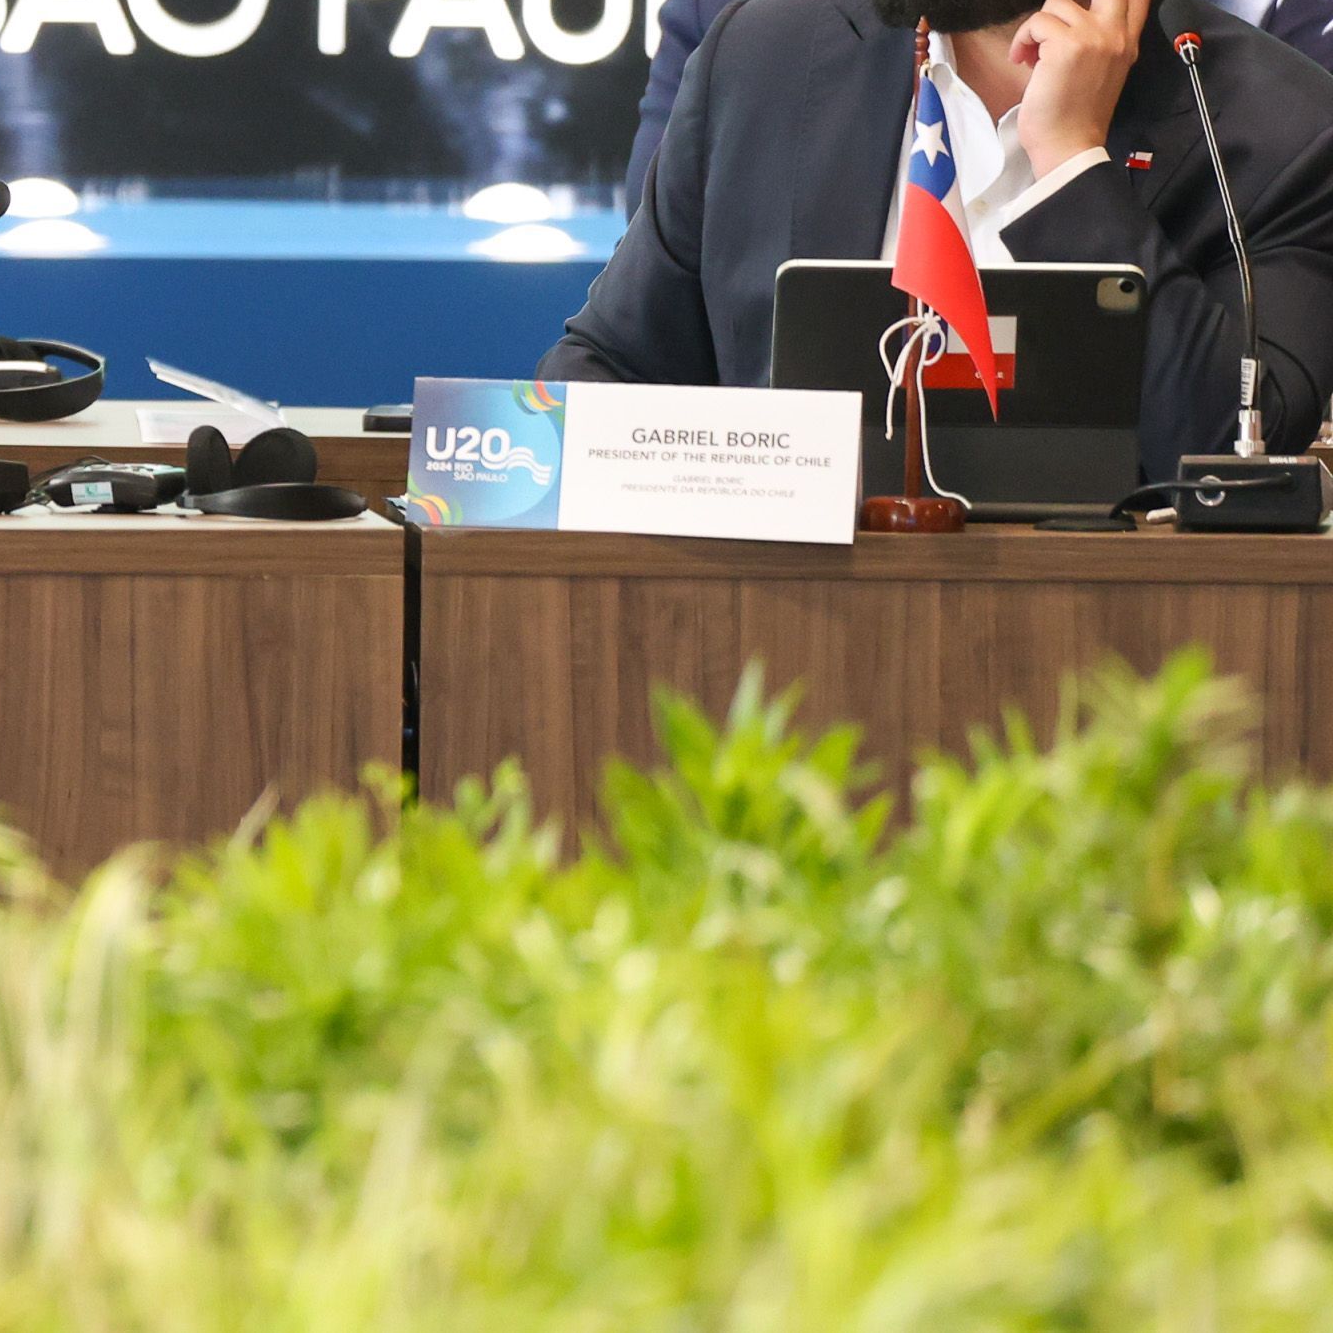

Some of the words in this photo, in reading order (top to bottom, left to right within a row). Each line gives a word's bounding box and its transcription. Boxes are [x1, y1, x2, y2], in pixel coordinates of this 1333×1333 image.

[425, 426, 511, 463] U20
[631, 427, 719, 447] GABRIEL
[726, 430, 791, 449] BORIC
[425, 461, 452, 472] 2024
[453, 462, 474, 472] RIO
[588, 448, 657, 461] PRESIDENT
[660, 451, 679, 461] OF
[682, 452, 707, 463] THE
[710, 453, 770, 465] REPUBLIC
[773, 455, 792, 466] OF
[794, 456, 832, 467] CHILE
